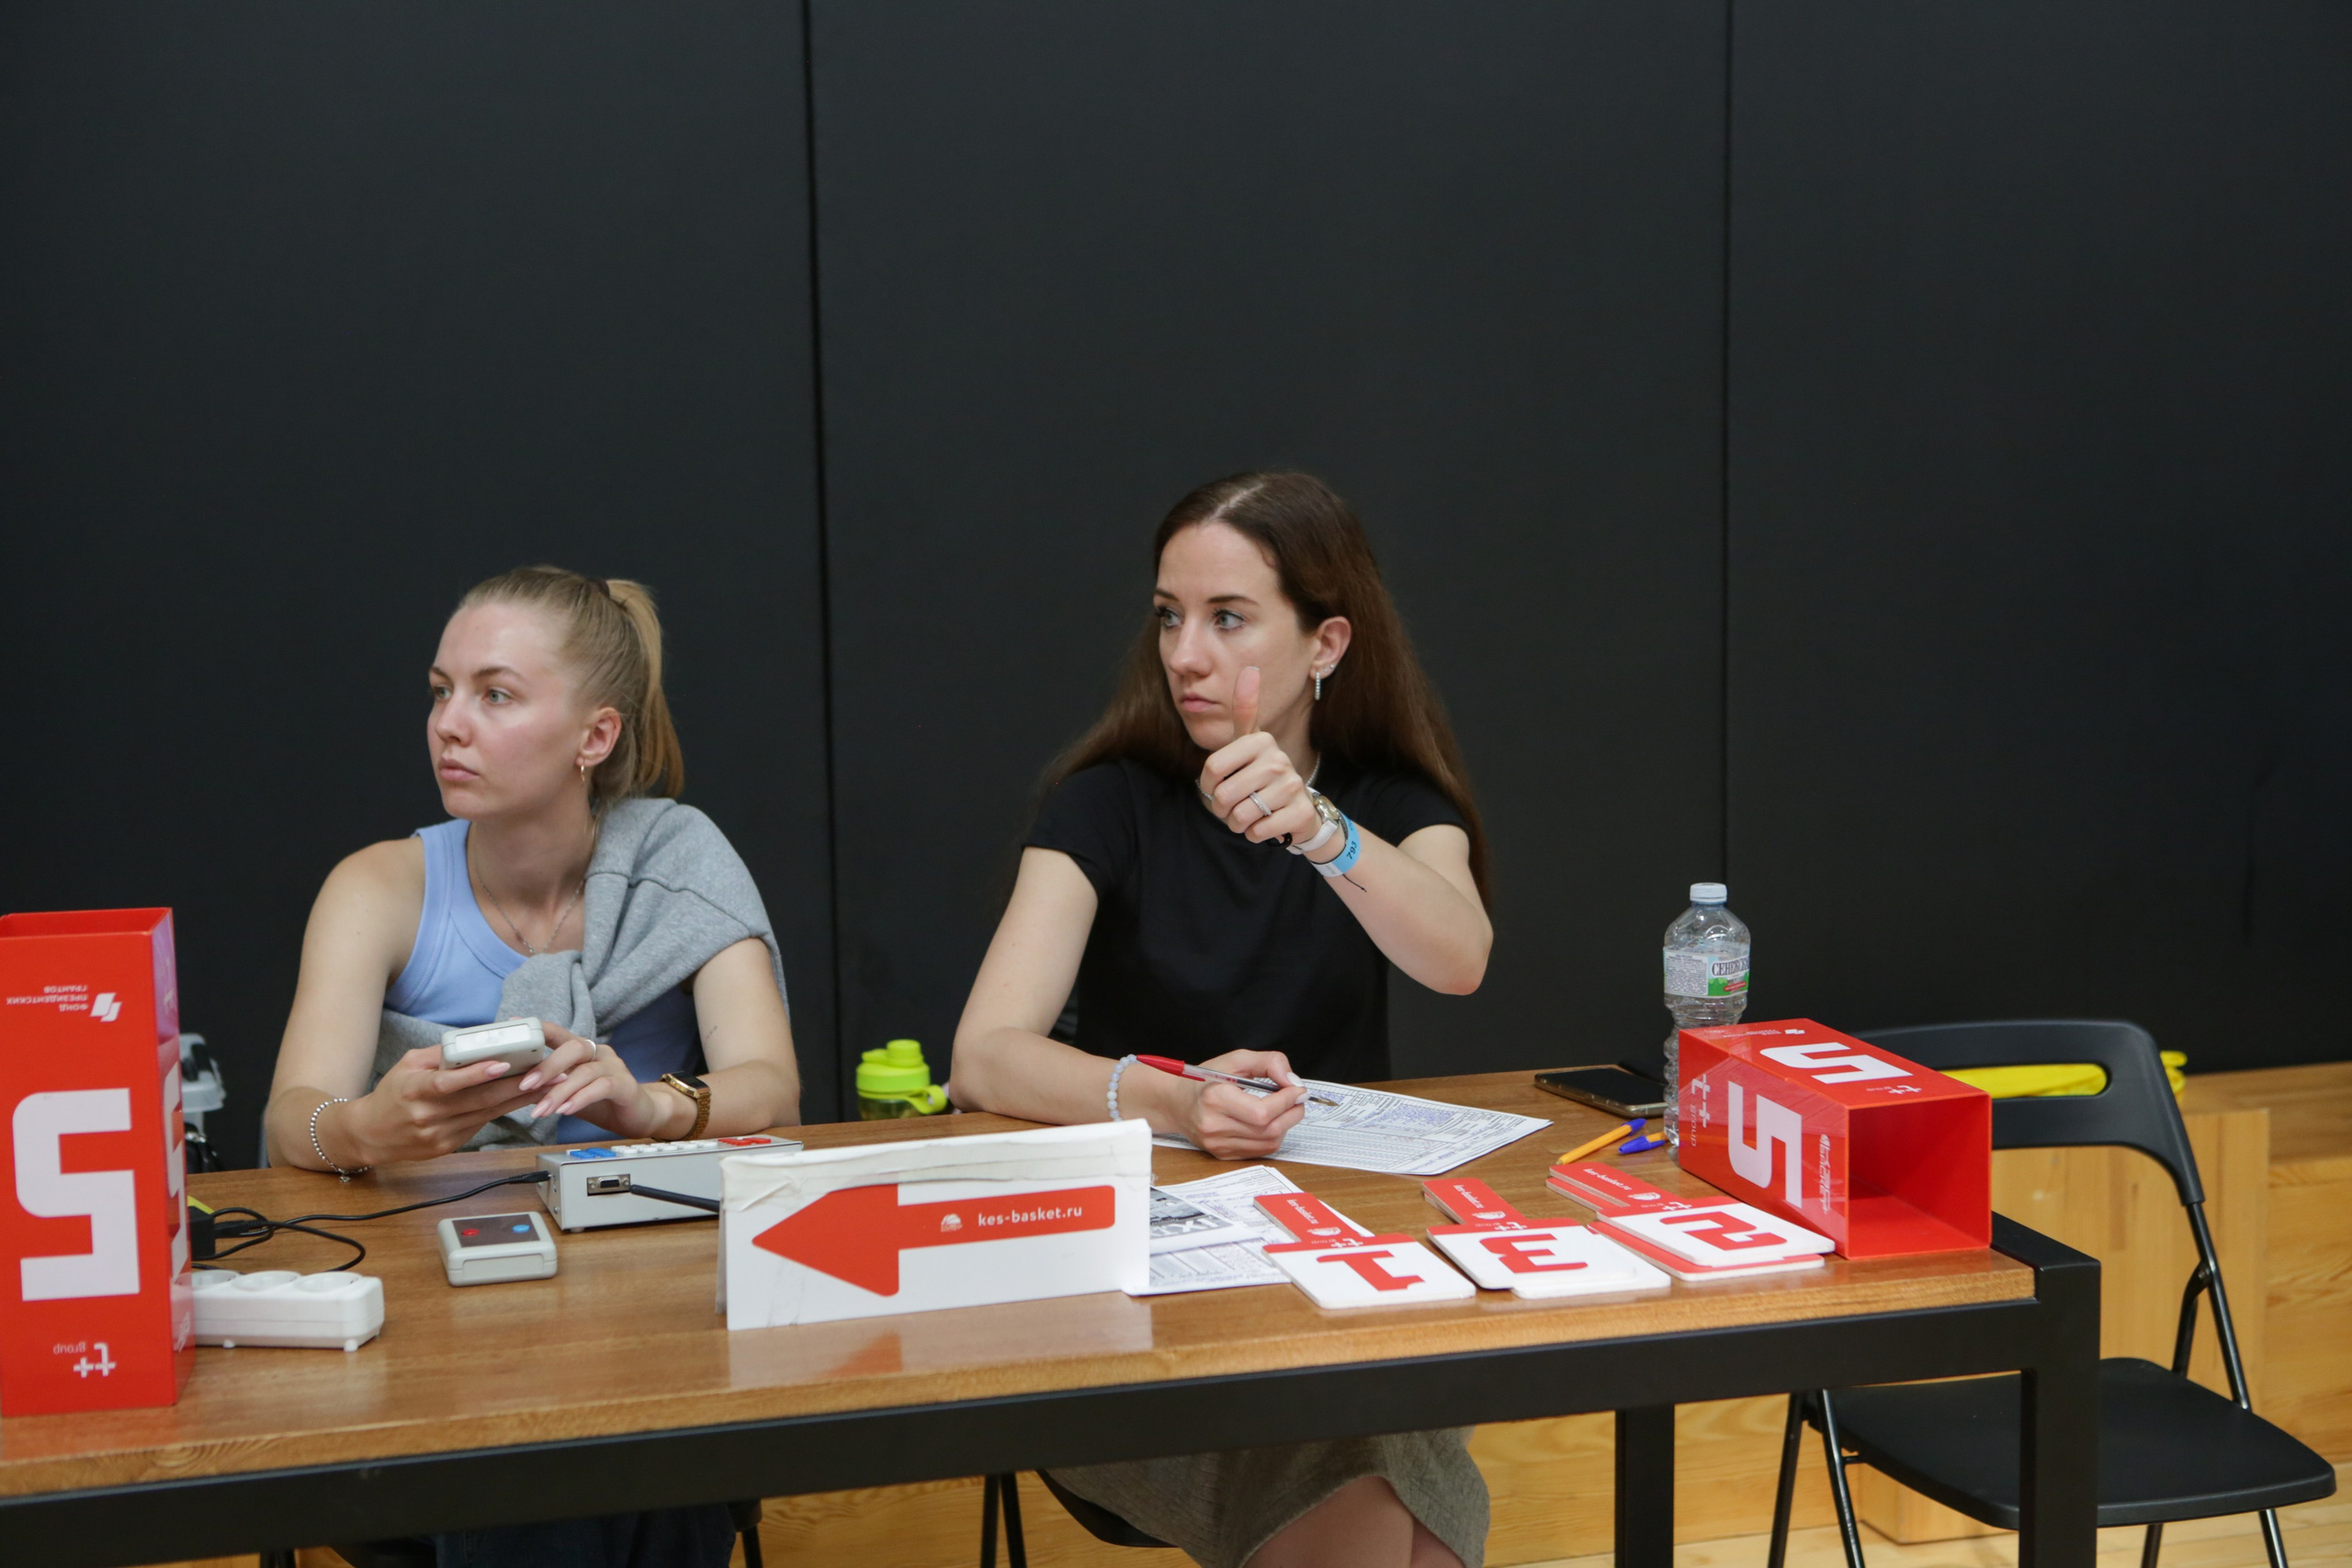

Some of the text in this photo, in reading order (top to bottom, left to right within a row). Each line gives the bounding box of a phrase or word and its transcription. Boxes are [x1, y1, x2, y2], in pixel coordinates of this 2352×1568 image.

[1759, 1042, 1914, 1085] 5
[1728, 1080, 1803, 1209] 5
[12, 1088, 141, 1302] 5
[978, 1206, 1083, 1226] kes-basket.ru
[1659, 1212, 1787, 1252] 2
[1316, 1250, 1425, 1292] 1
[1479, 1234, 1589, 1274] 3
[52, 1340, 86, 1355] group
